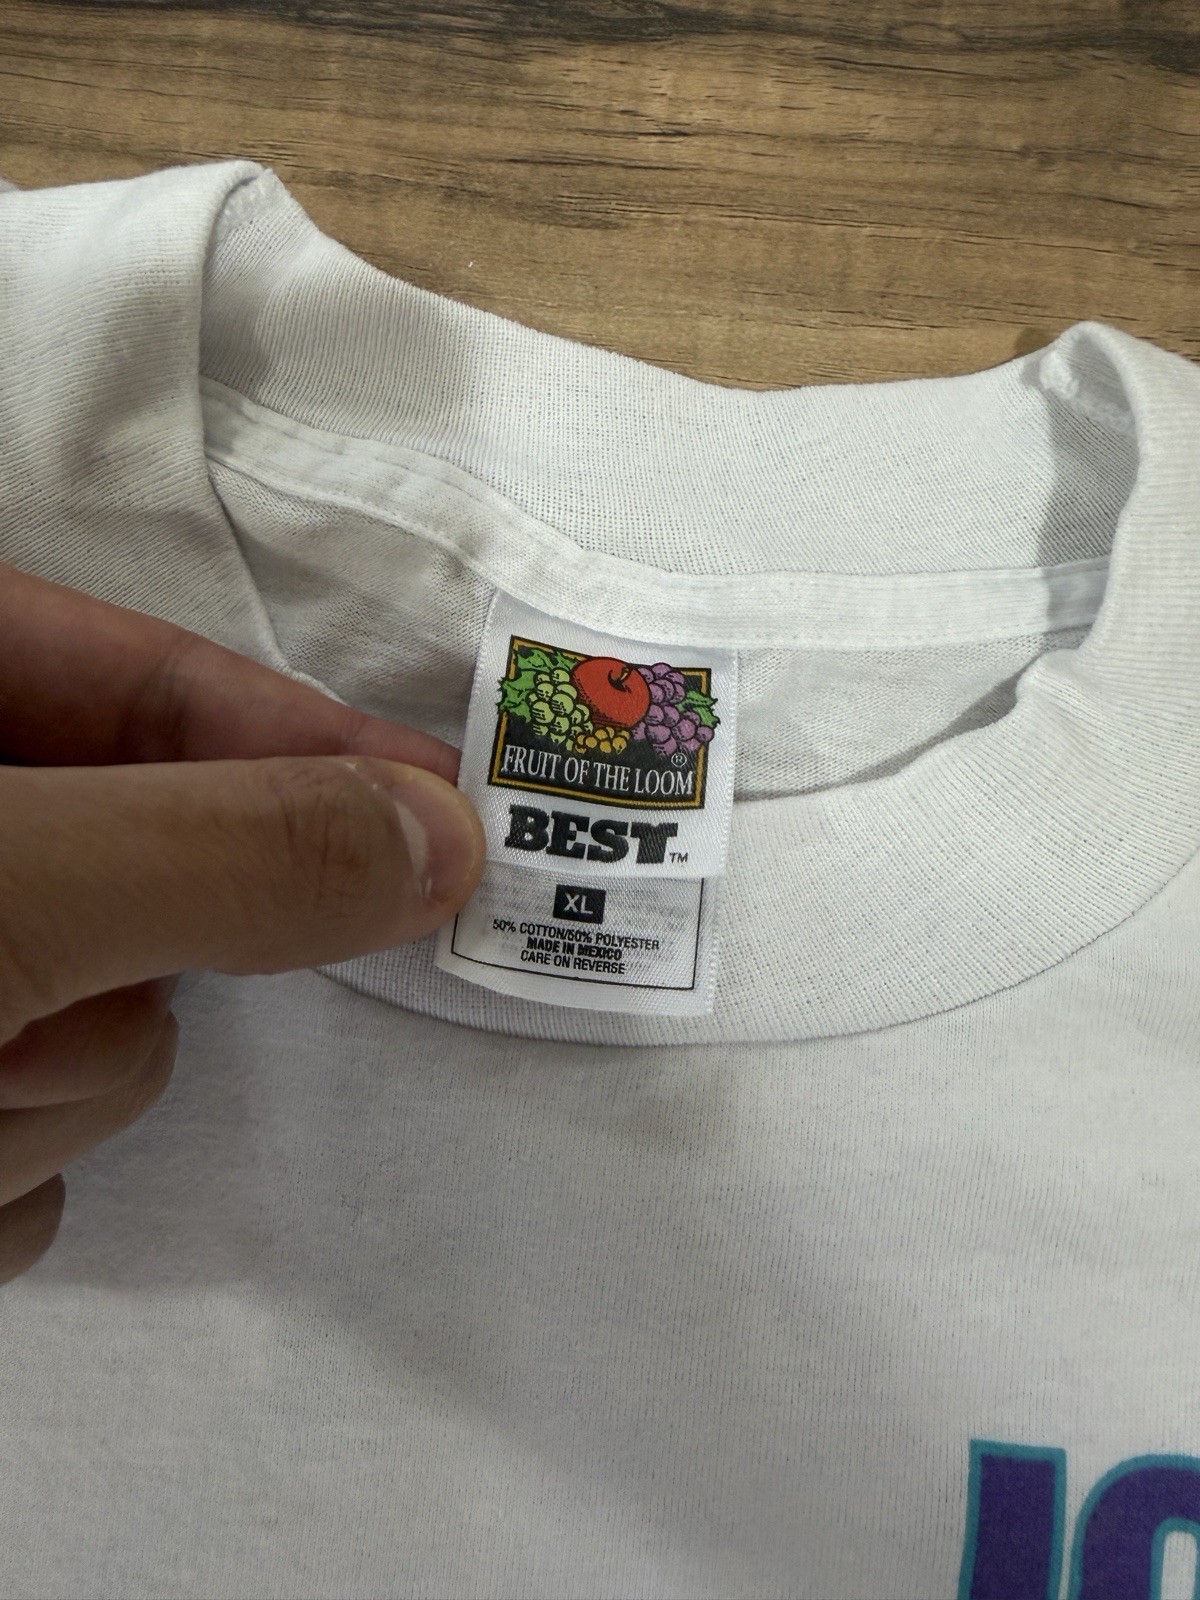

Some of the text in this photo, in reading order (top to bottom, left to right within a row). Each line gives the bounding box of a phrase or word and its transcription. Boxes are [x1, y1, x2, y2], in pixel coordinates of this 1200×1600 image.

[500, 744, 694, 796] FRUIT OF THE LOOM
[504, 803, 679, 864] BEST
[563, 892, 594, 915] XL
[492, 918, 660, 951] 50% COTTON/50% POLYESTER
[526, 937, 623, 961] MADE IN MEXICO
[520, 950, 626, 975] CARE ON REVERSE
